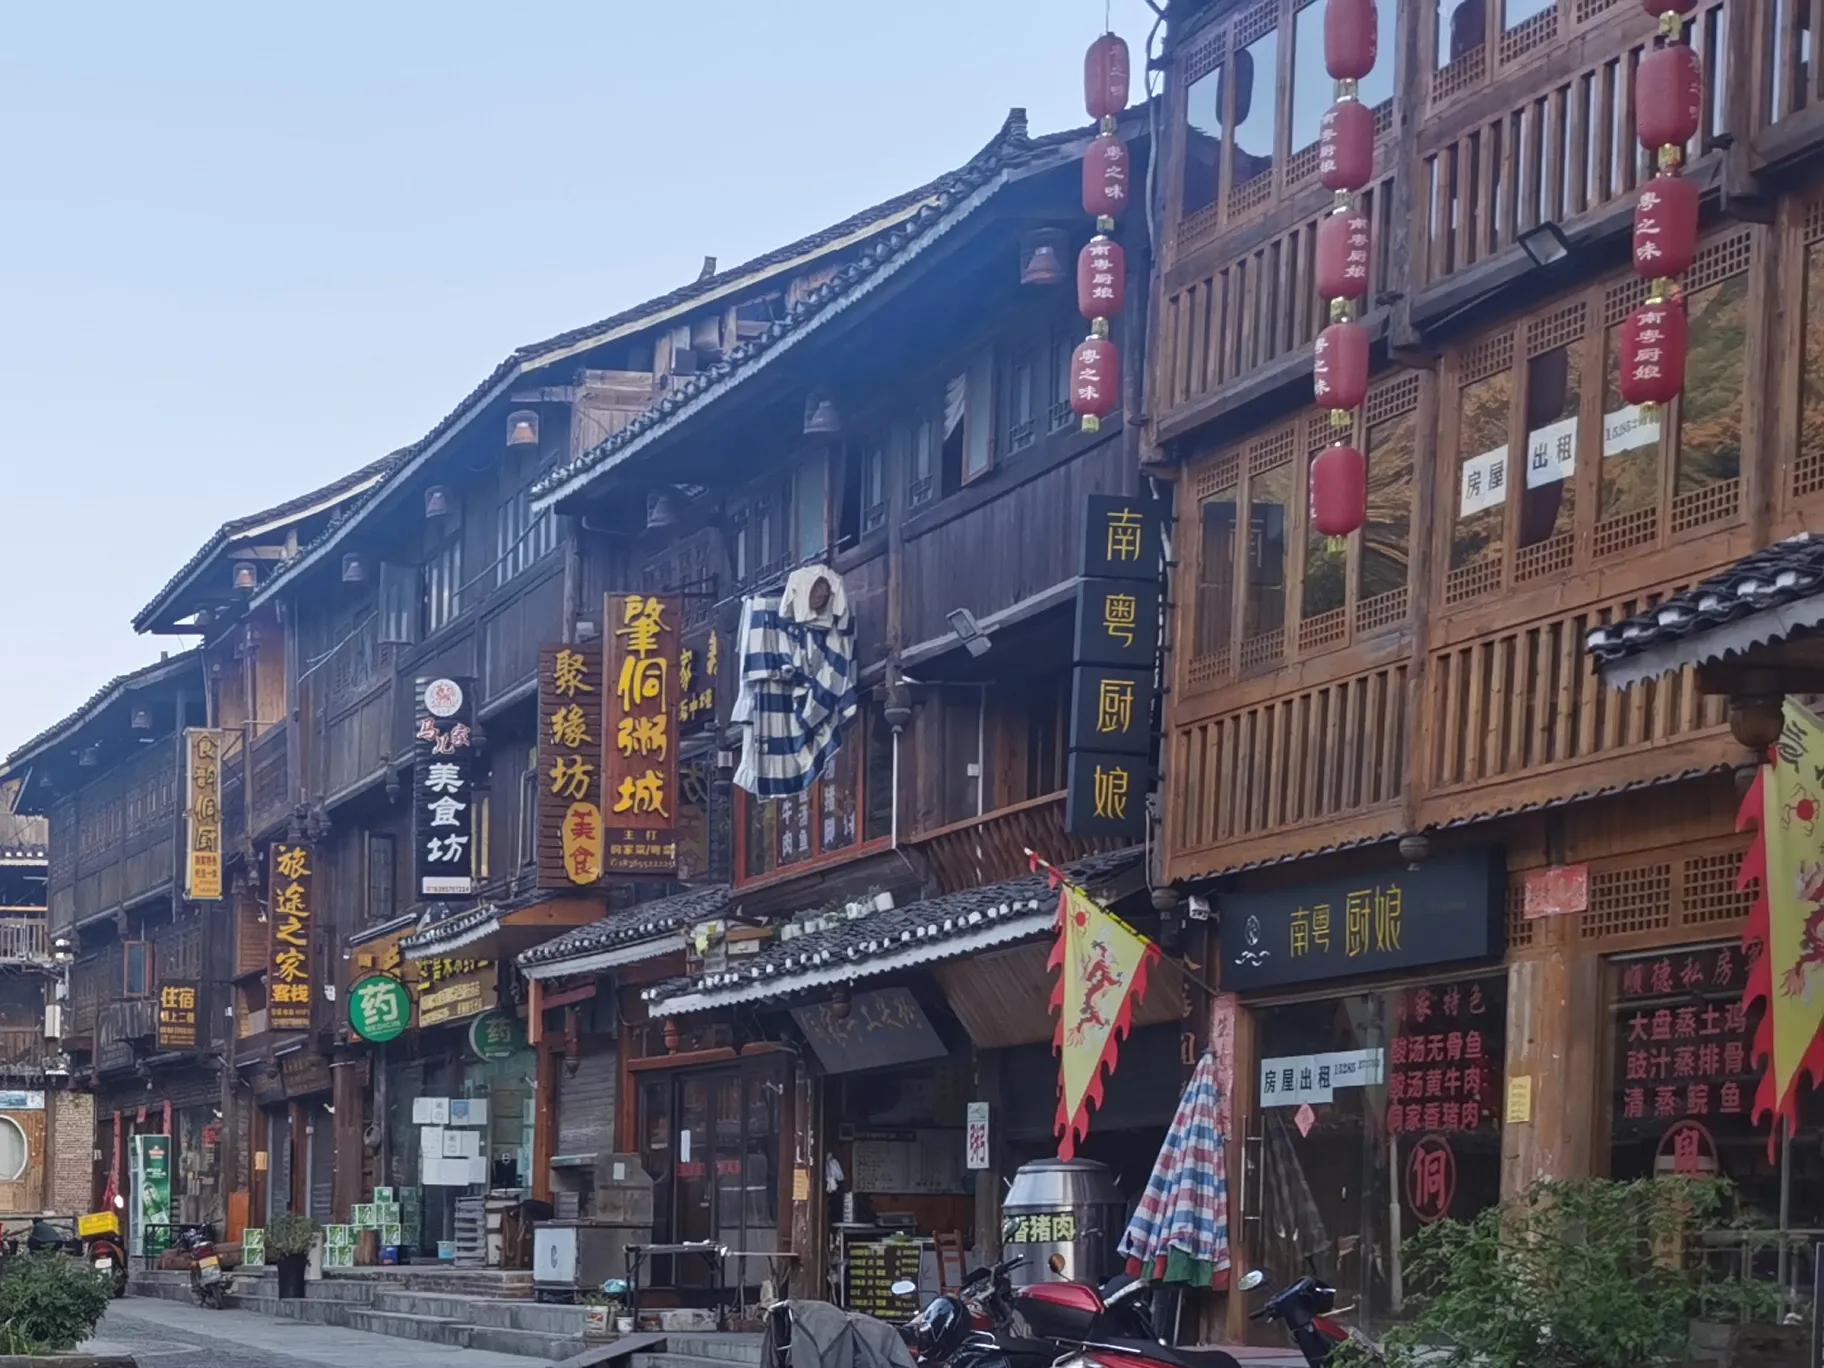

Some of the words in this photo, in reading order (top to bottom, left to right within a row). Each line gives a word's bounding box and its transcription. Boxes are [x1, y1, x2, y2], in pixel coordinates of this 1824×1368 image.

[1104, 145, 1124, 199] 粤之味
[1636, 191, 1662, 261] 粤之味
[1089, 245, 1114, 299] 南粤厨娘
[1079, 348, 1100, 400] 粤之味
[1633, 311, 1666, 380] 南粤厨娘
[1093, 508, 1143, 819] 南粤厨娘
[549, 649, 595, 801] 聚缘坊
[424, 762, 469, 863] 美食坊
[569, 810, 596, 877] 美食
[275, 845, 312, 982] 旅途之家
[1290, 883, 1403, 957] 南粤厨娘
[161, 986, 195, 1009] 住宿
[358, 981, 400, 1026] 药
[1628, 1004, 1747, 1042] 大盘蒸土鸡
[1391, 1030, 1482, 1064] 酸汤无骨鱼
[1627, 1042, 1744, 1079] 豉汁蒸排骨
[1264, 1065, 1331, 1093] 房屋出租
[1412, 1147, 1447, 1209] 侗
